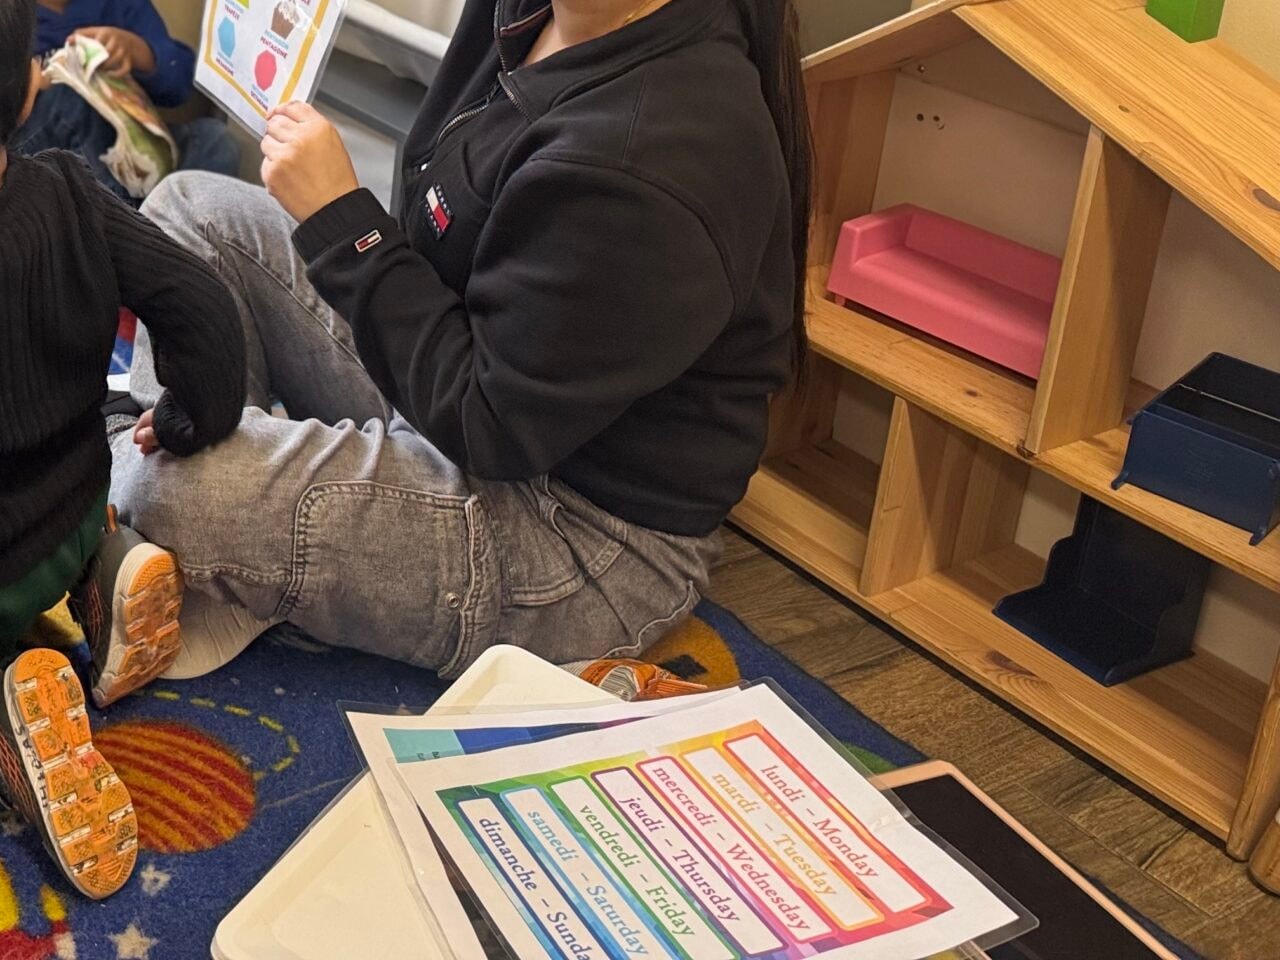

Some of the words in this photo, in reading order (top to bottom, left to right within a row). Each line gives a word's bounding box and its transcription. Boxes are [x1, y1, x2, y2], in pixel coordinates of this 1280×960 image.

[261, 36, 288, 59] PENTAGONE
[528, 810, 579, 862] samedi
[587, 885, 649, 956] Saturday
[579, 805, 641, 868] vendredi
[644, 885, 695, 938] Friday
[619, 797, 666, 833] jeudi
[672, 850, 740, 923] Thursday
[652, 767, 717, 827] mercredi
[726, 844, 811, 934] Wednesday
[712, 773, 761, 813] mardi
[775, 833, 837, 897] Tuesday
[761, 764, 806, 803] lundi
[813, 818, 879, 879] Monday
[479, 817, 537, 891] dimanche
[547, 912, 592, 960] Sunda
